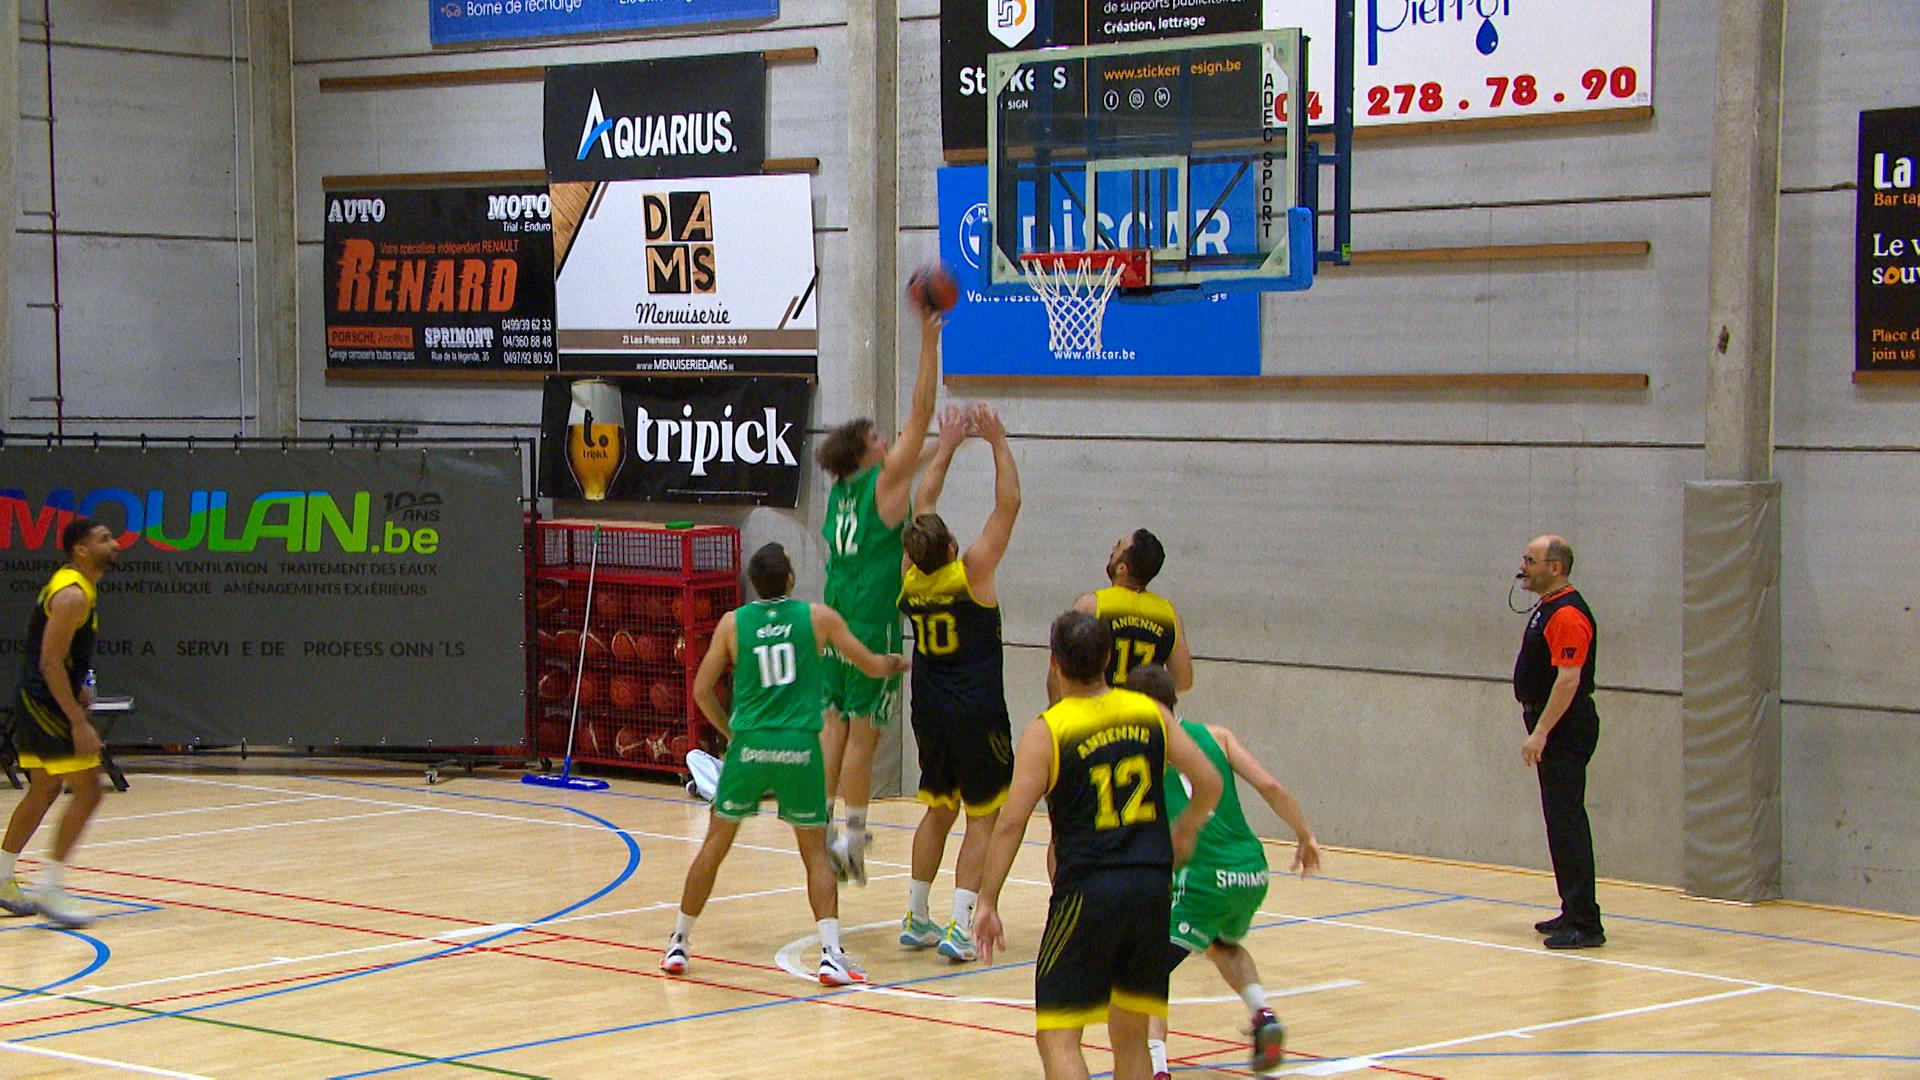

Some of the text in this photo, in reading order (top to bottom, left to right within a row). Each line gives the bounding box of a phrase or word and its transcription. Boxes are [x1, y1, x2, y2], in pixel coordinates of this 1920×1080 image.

[467, 1, 501, 16] Borne
[505, 0, 522, 14] de
[1104, 2, 1117, 13] de
[1120, 0, 1170, 13] supports
[1104, 14, 1206, 34] Création, lettrage
[1368, 82, 1443, 115] 278
[1486, 74, 1537, 107] 78
[1581, 66, 1637, 100] 90
[1873, 152, 1914, 189] La
[1262, 152, 1273, 238] SPORT
[1874, 192, 1899, 206] Bar
[328, 198, 386, 223] AUTO
[487, 194, 552, 221] MOTO
[503, 221, 518, 232] Trial
[524, 221, 551, 232] Enduro
[482, 239, 519, 253] RENAULT
[1873, 233, 1904, 258] Le
[336, 238, 518, 313] RENARD
[635, 302, 732, 325] Menuiserie
[542, 318, 552, 331] 33
[332, 331, 374, 344] PORSCHE
[425, 327, 494, 348] SPRIMONT
[542, 335, 553, 348] 48
[1872, 328, 1908, 342] Place
[431, 351, 443, 362] Rue
[443, 351, 451, 362] de
[533, 351, 543, 364] 80
[543, 351, 553, 364] 50
[1054, 348, 1136, 360] www.discar.be
[1872, 347, 1916, 362] join us
[637, 404, 798, 477] tripick
[401, 509, 441, 522] ANS
[835, 511, 859, 557] 12
[176, 560, 268, 574] VENTILATION
[280, 562, 367, 576] TRAITEMENT
[370, 563, 396, 576] DES
[399, 563, 437, 576] EAUX
[125, 579, 212, 596] MÉTALLIQUE
[223, 580, 342, 596] AMÉNAGEMENTS
[911, 612, 960, 656] 10
[752, 642, 797, 688] 10
[1113, 638, 1156, 684] 17
[1090, 753, 1157, 830] 12
